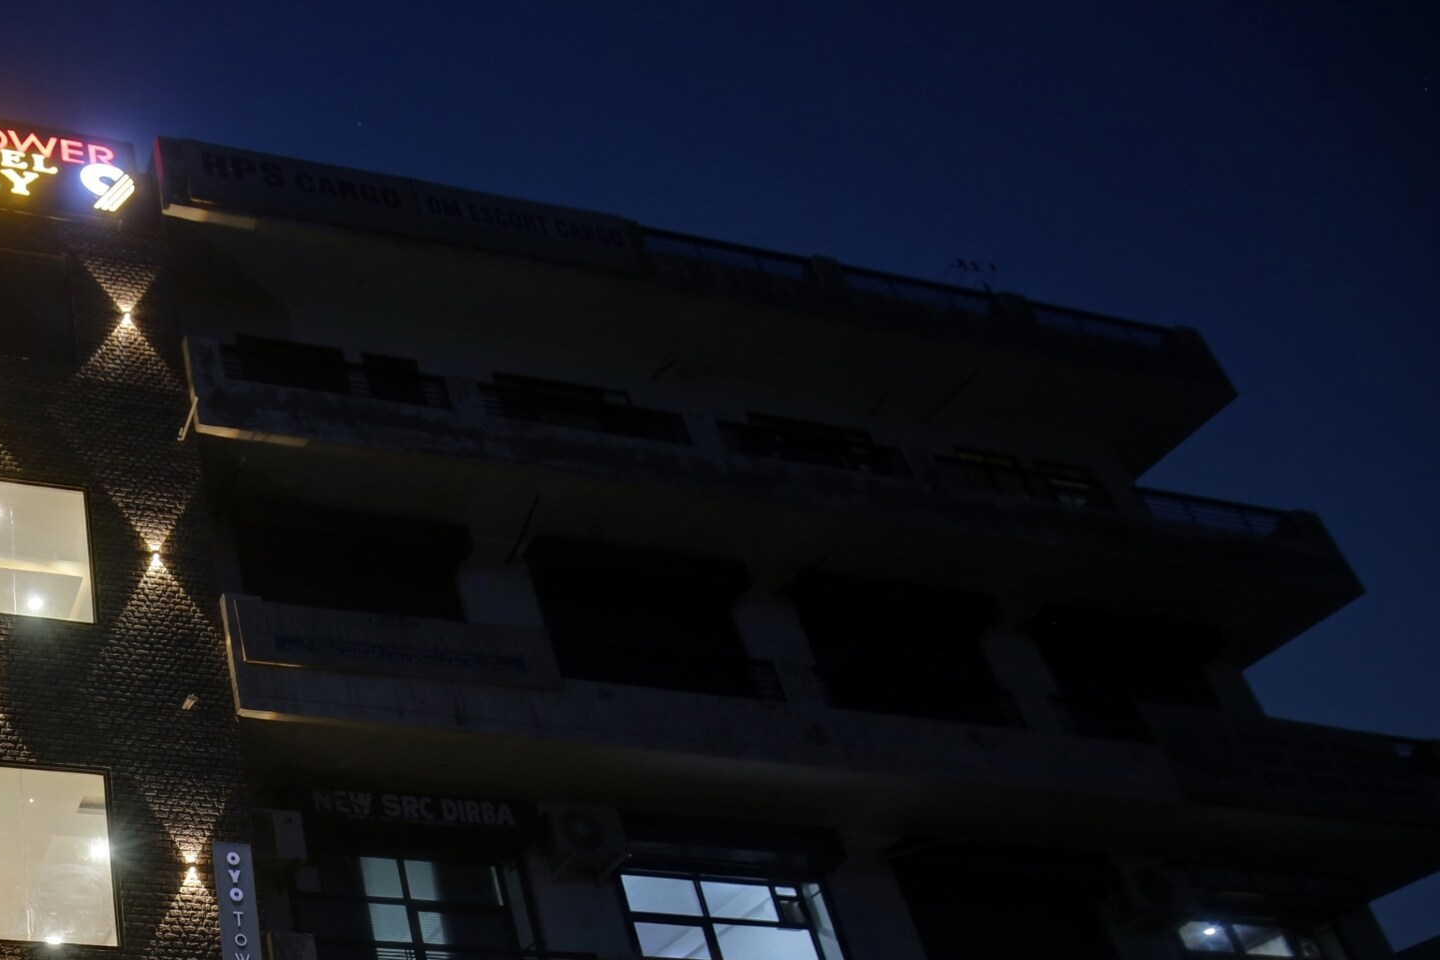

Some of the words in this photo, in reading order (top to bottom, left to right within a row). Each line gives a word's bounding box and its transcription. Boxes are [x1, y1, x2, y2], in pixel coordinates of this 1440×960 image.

[79, 162, 136, 212] 9
[200, 149, 286, 188] RPS
[296, 171, 401, 209] CARGO
[427, 194, 462, 219] OM
[470, 206, 548, 238] ESCORT
[554, 220, 624, 249] CARGO
[312, 788, 373, 815] NEW
[380, 793, 436, 821] SRC
[440, 797, 517, 827] DIRBA
[226, 850, 244, 902] OYO
